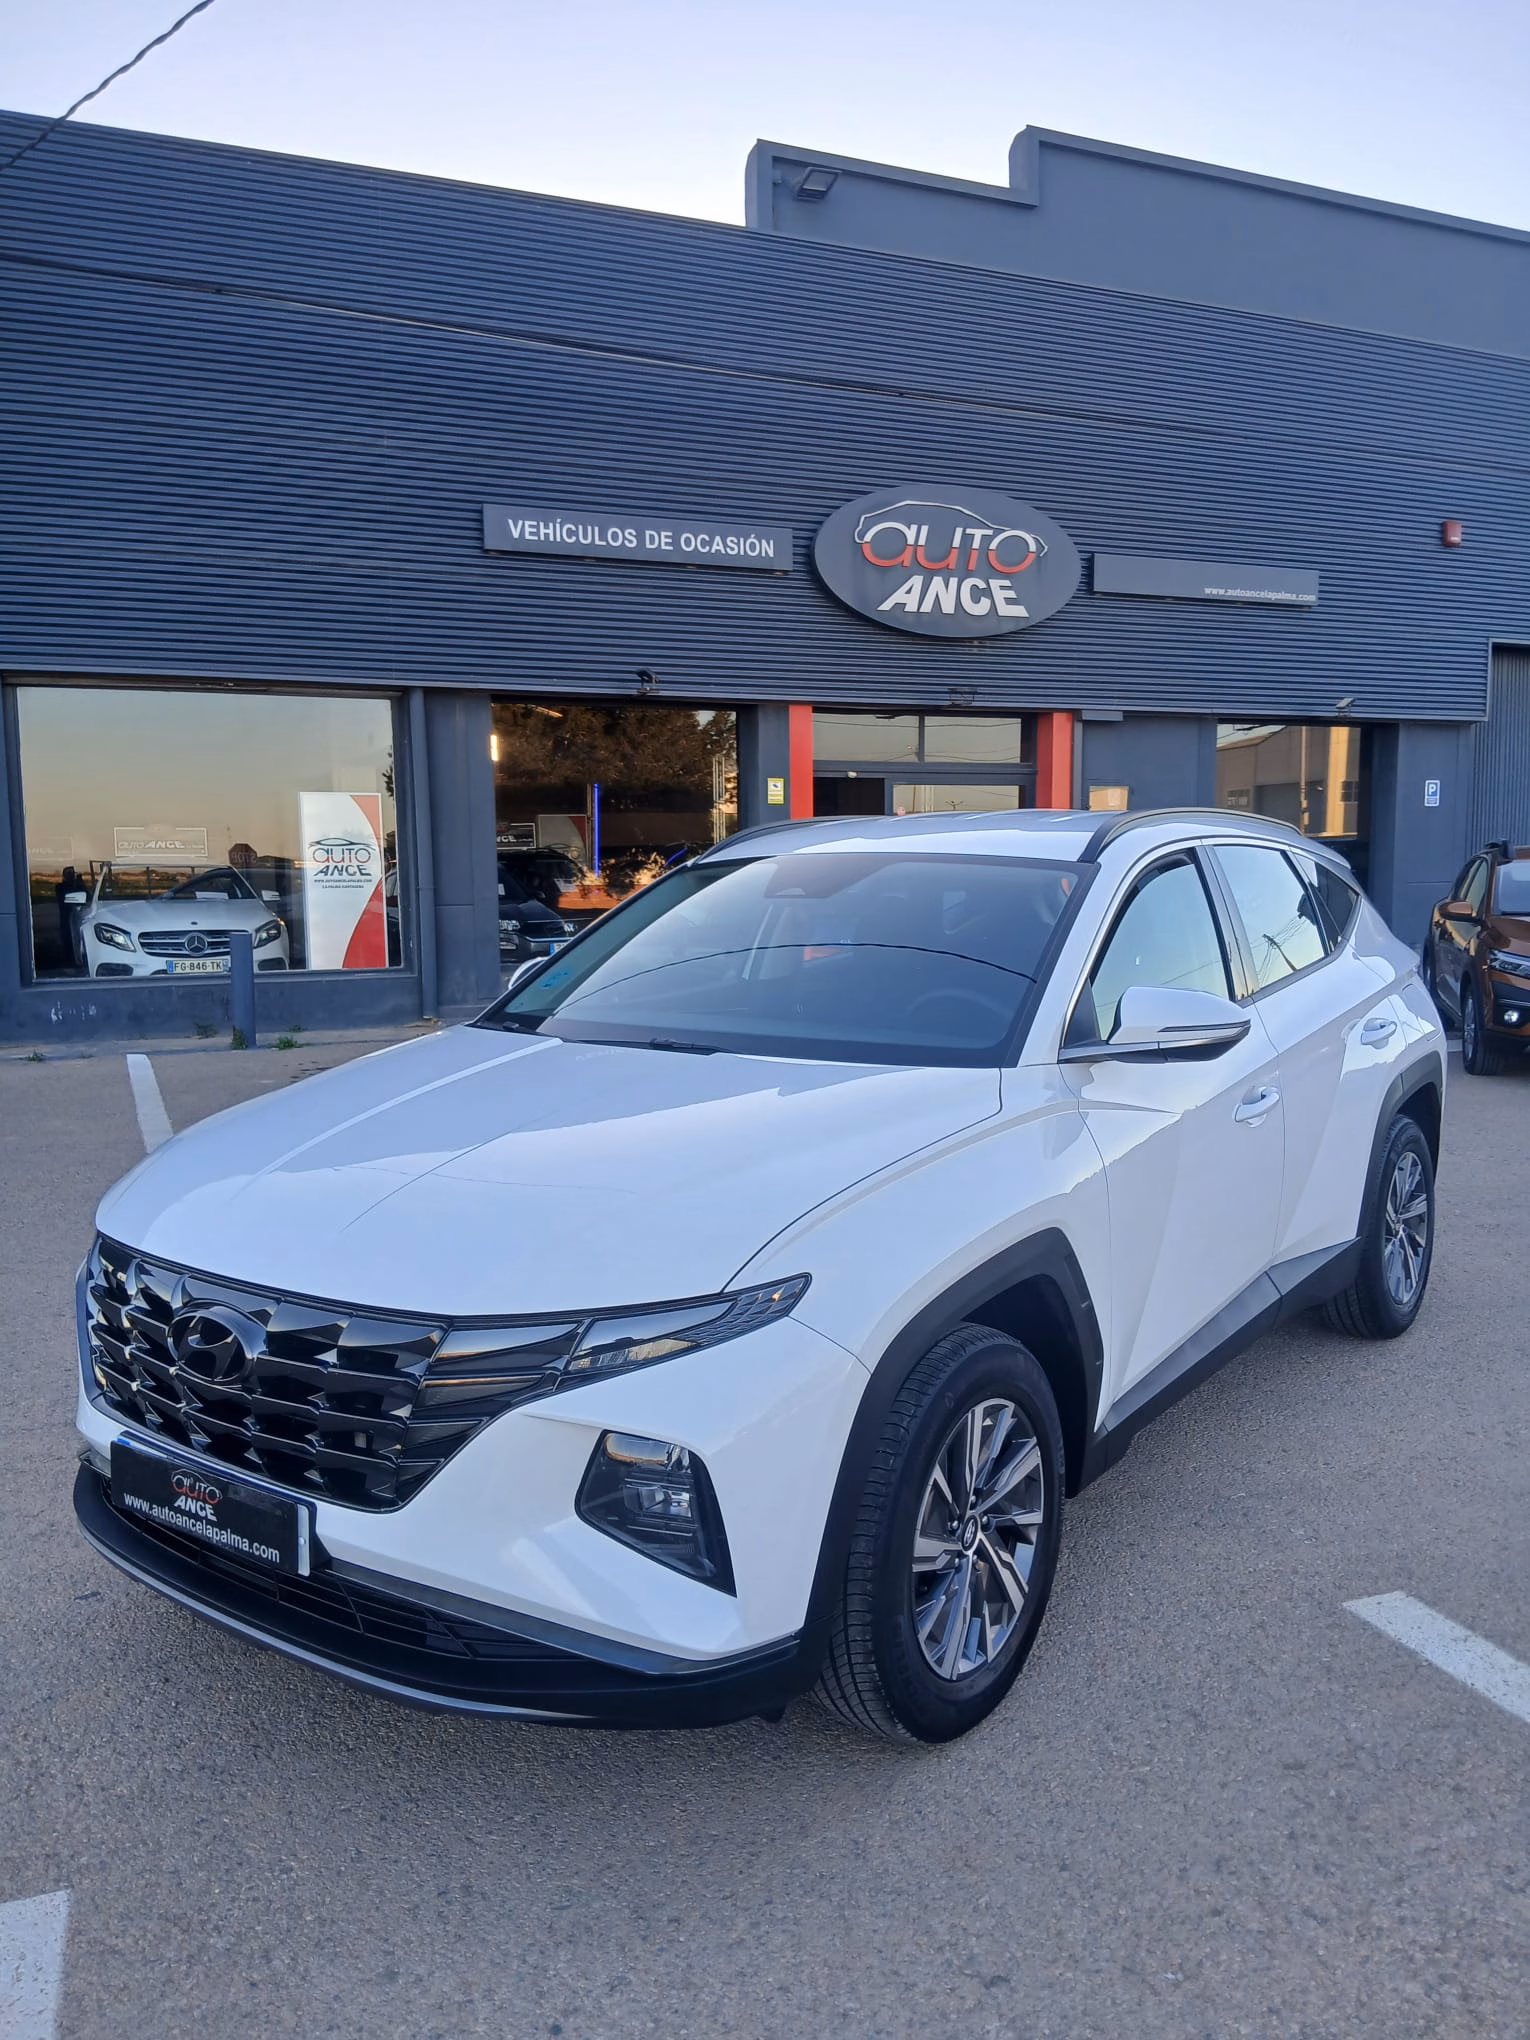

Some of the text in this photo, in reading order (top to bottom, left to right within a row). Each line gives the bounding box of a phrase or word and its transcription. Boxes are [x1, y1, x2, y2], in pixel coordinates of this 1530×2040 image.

[507, 518, 775, 558] VEHÍCULOS DE OCASIÓN
[877, 574, 1030, 618] ANCE
[1204, 587, 1317, 601] www.autoancelapalma.com
[1429, 783, 1436, 796] P
[313, 864, 372, 877] ANCE
[173, 1495, 218, 1522] ANCE
[123, 1491, 280, 1563] www.autoancelapalma.com
